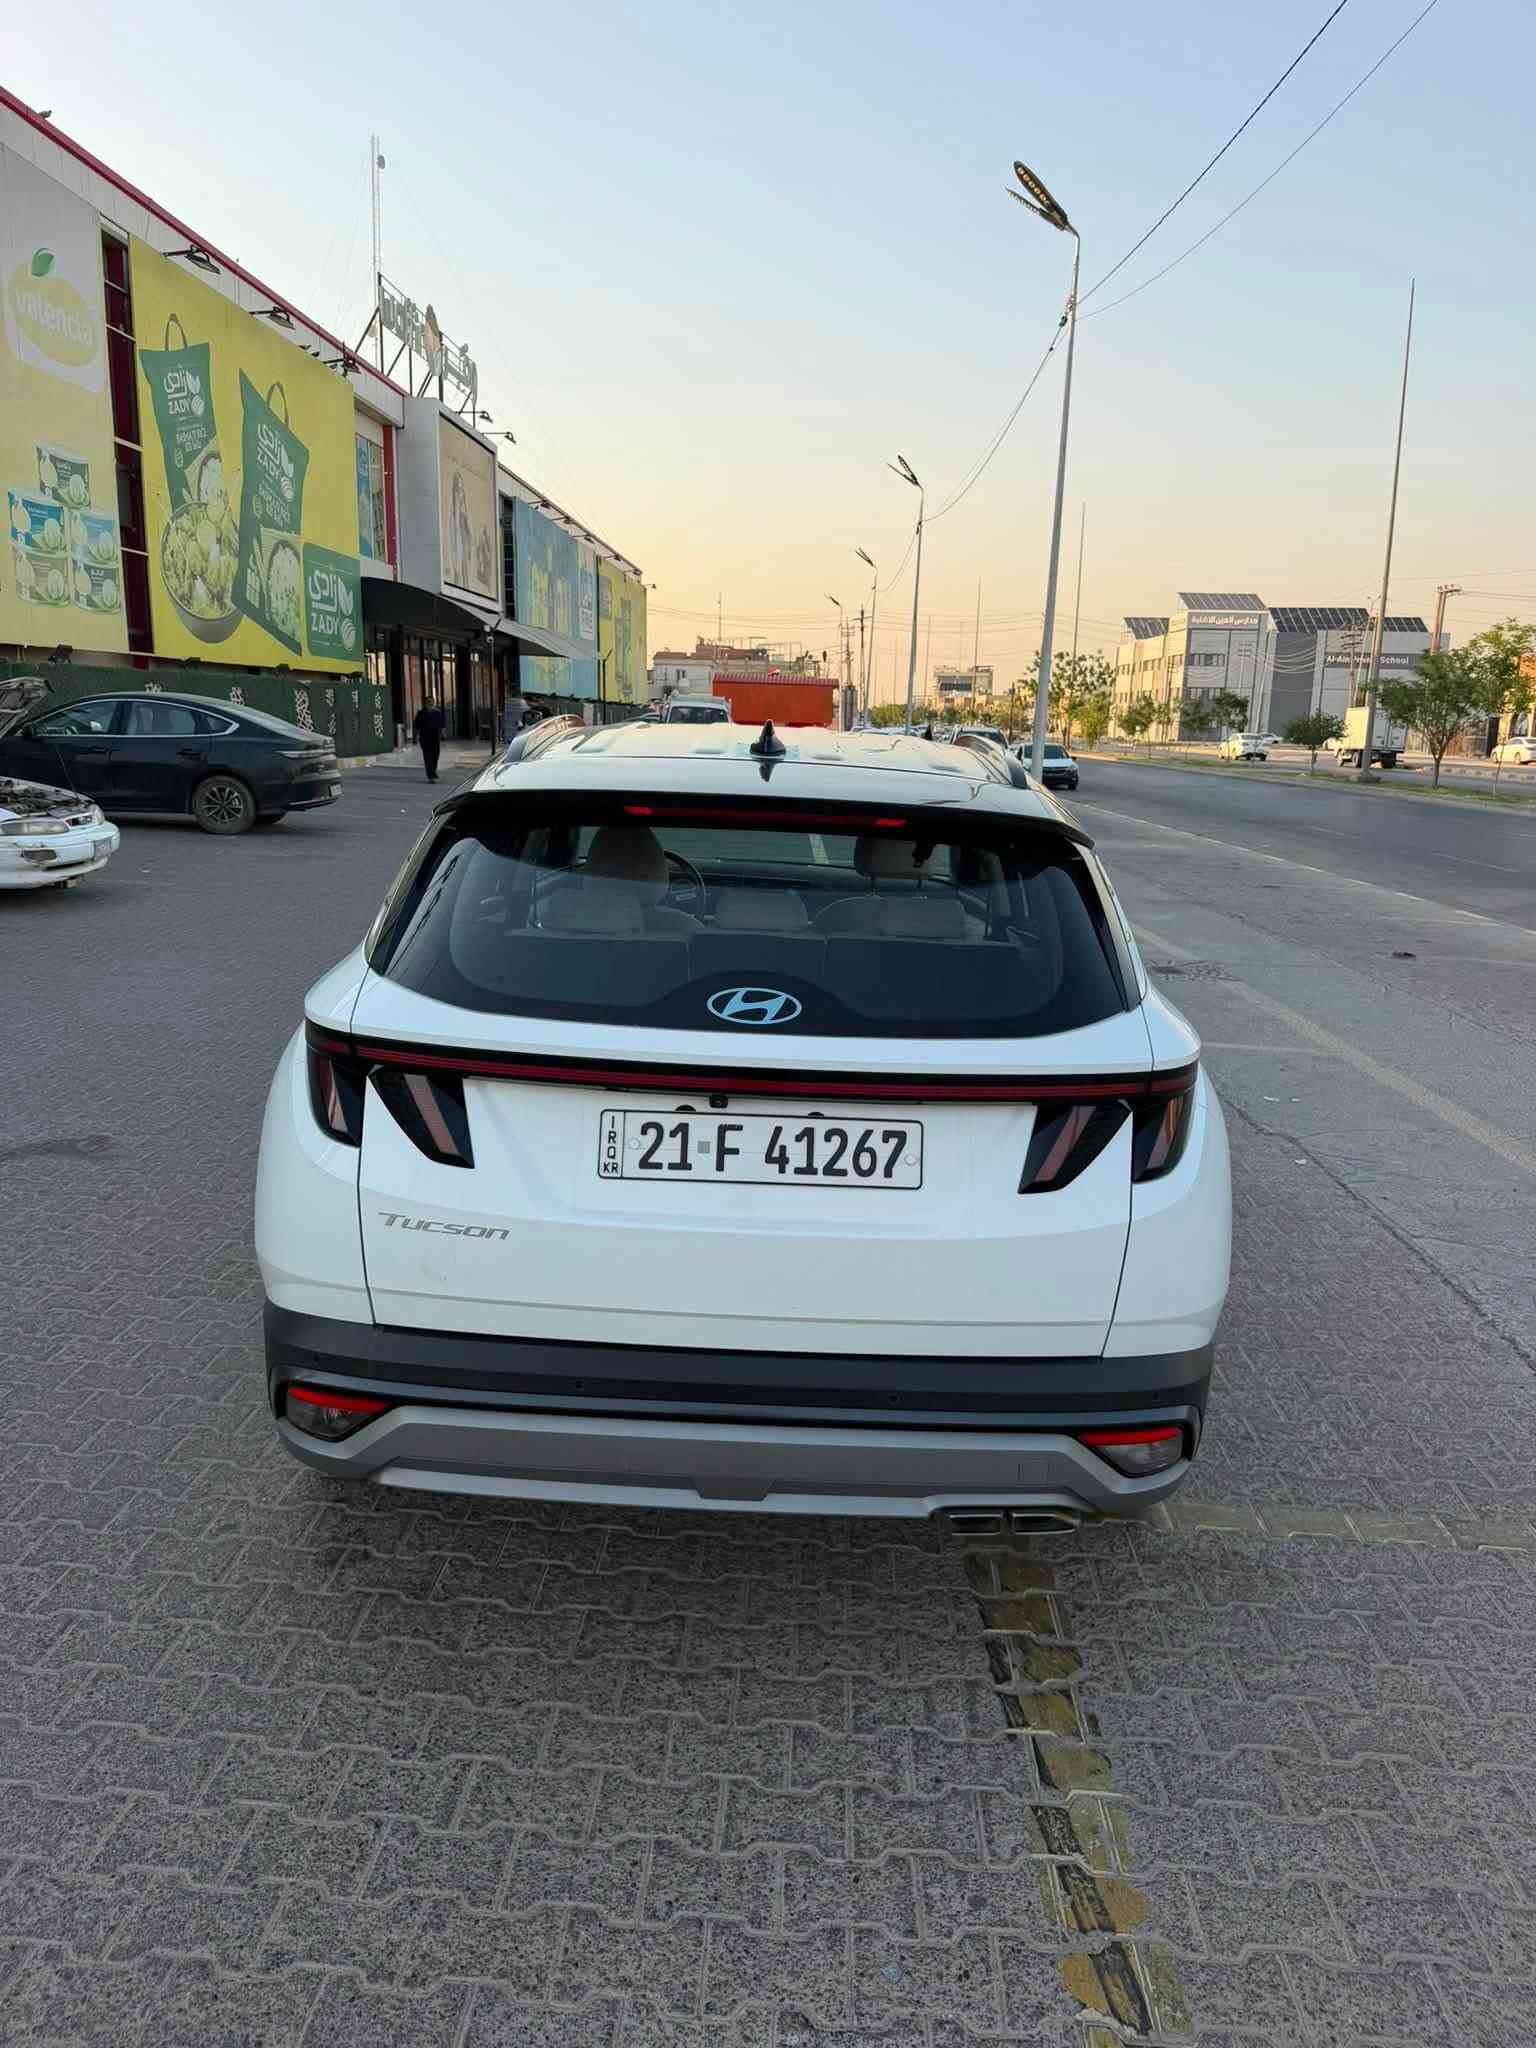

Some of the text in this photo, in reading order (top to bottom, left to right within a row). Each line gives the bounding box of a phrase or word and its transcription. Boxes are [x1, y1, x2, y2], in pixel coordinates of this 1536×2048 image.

[167, 398, 191, 415] ZADY
[256, 446, 281, 482] ZADY
[310, 612, 340, 635] ZADY
[1380, 656, 1409, 665] School
[638, 1121, 908, 1178] 21 F 41267
